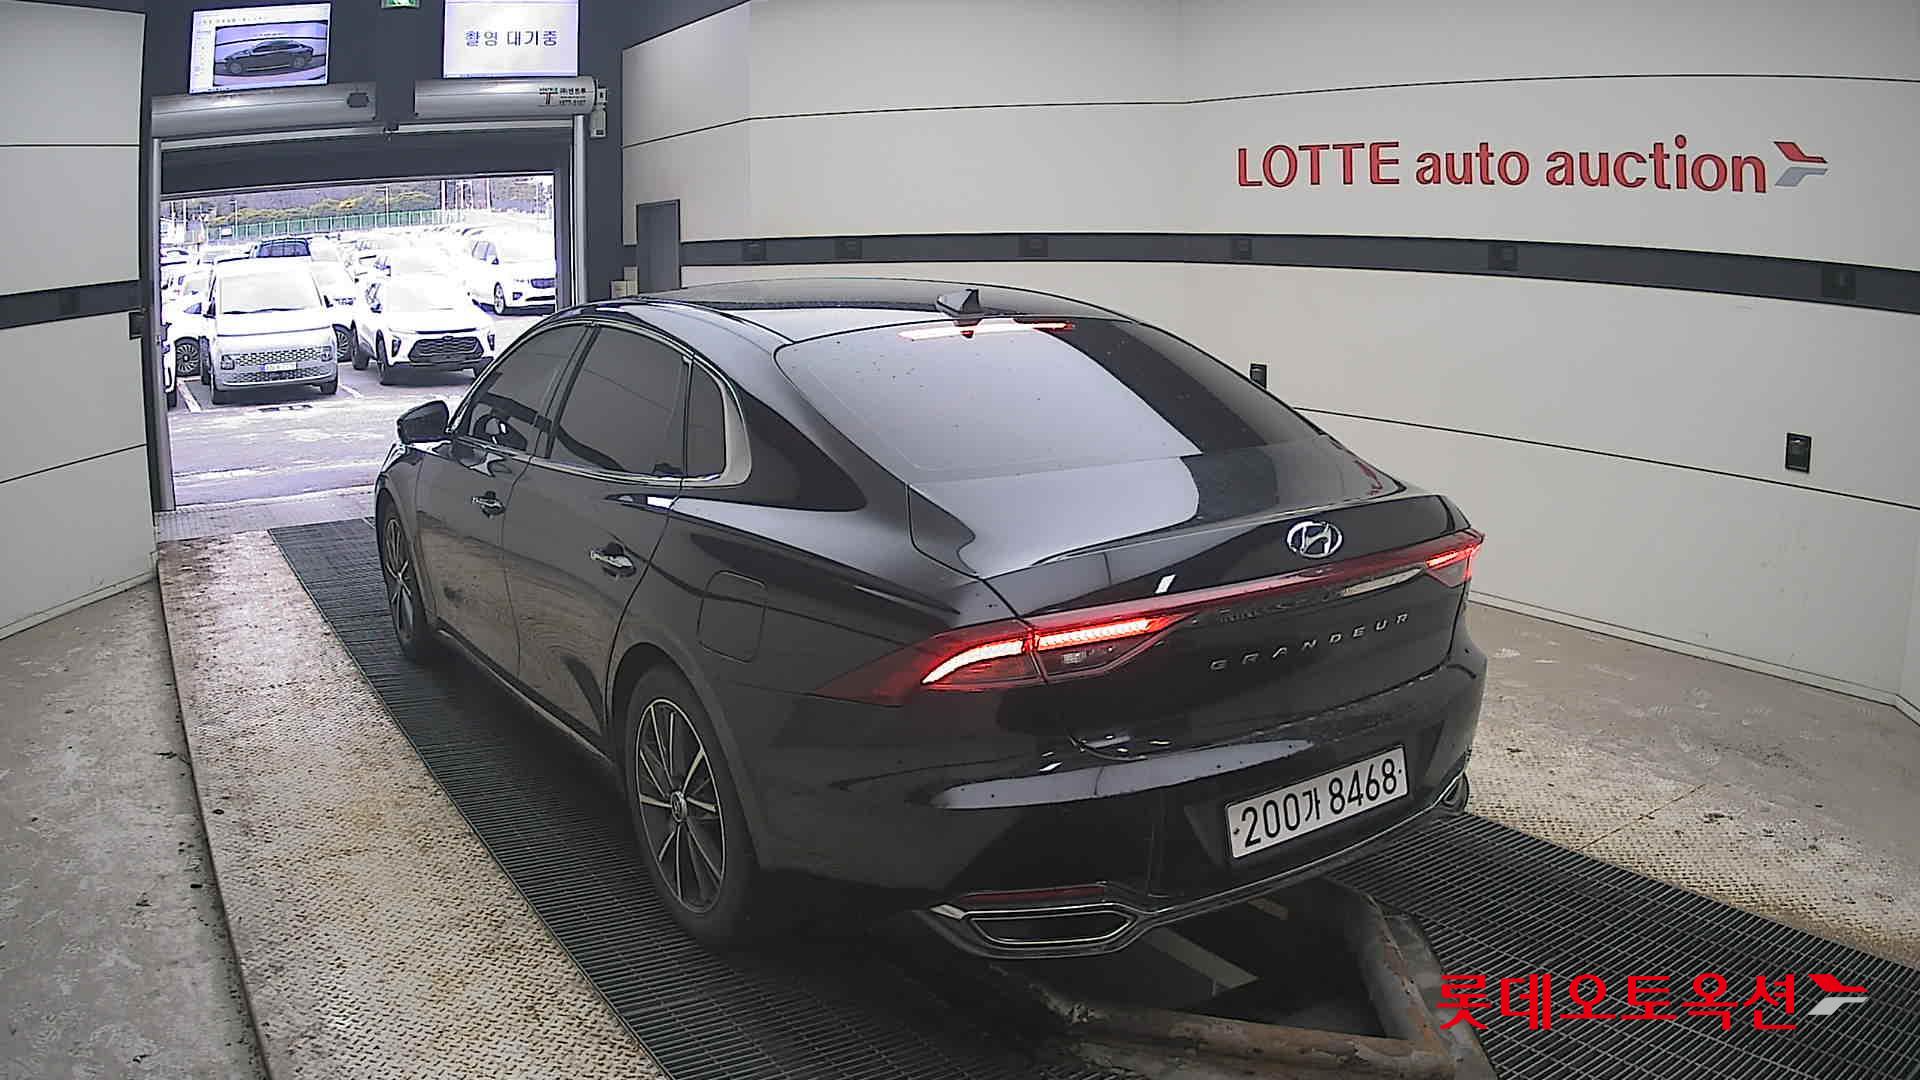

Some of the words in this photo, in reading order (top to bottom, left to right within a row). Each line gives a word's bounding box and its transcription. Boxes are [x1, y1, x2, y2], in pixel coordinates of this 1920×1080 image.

[507, 30, 557, 47] 대기중
[1238, 141, 1400, 188] LOTTE
[1415, 142, 1530, 186] auto
[1545, 135, 1767, 193] auction
[1210, 613, 1409, 671] GRANDEUR
[1241, 787, 1321, 848] 200가
[1328, 758, 1397, 815] 8468
